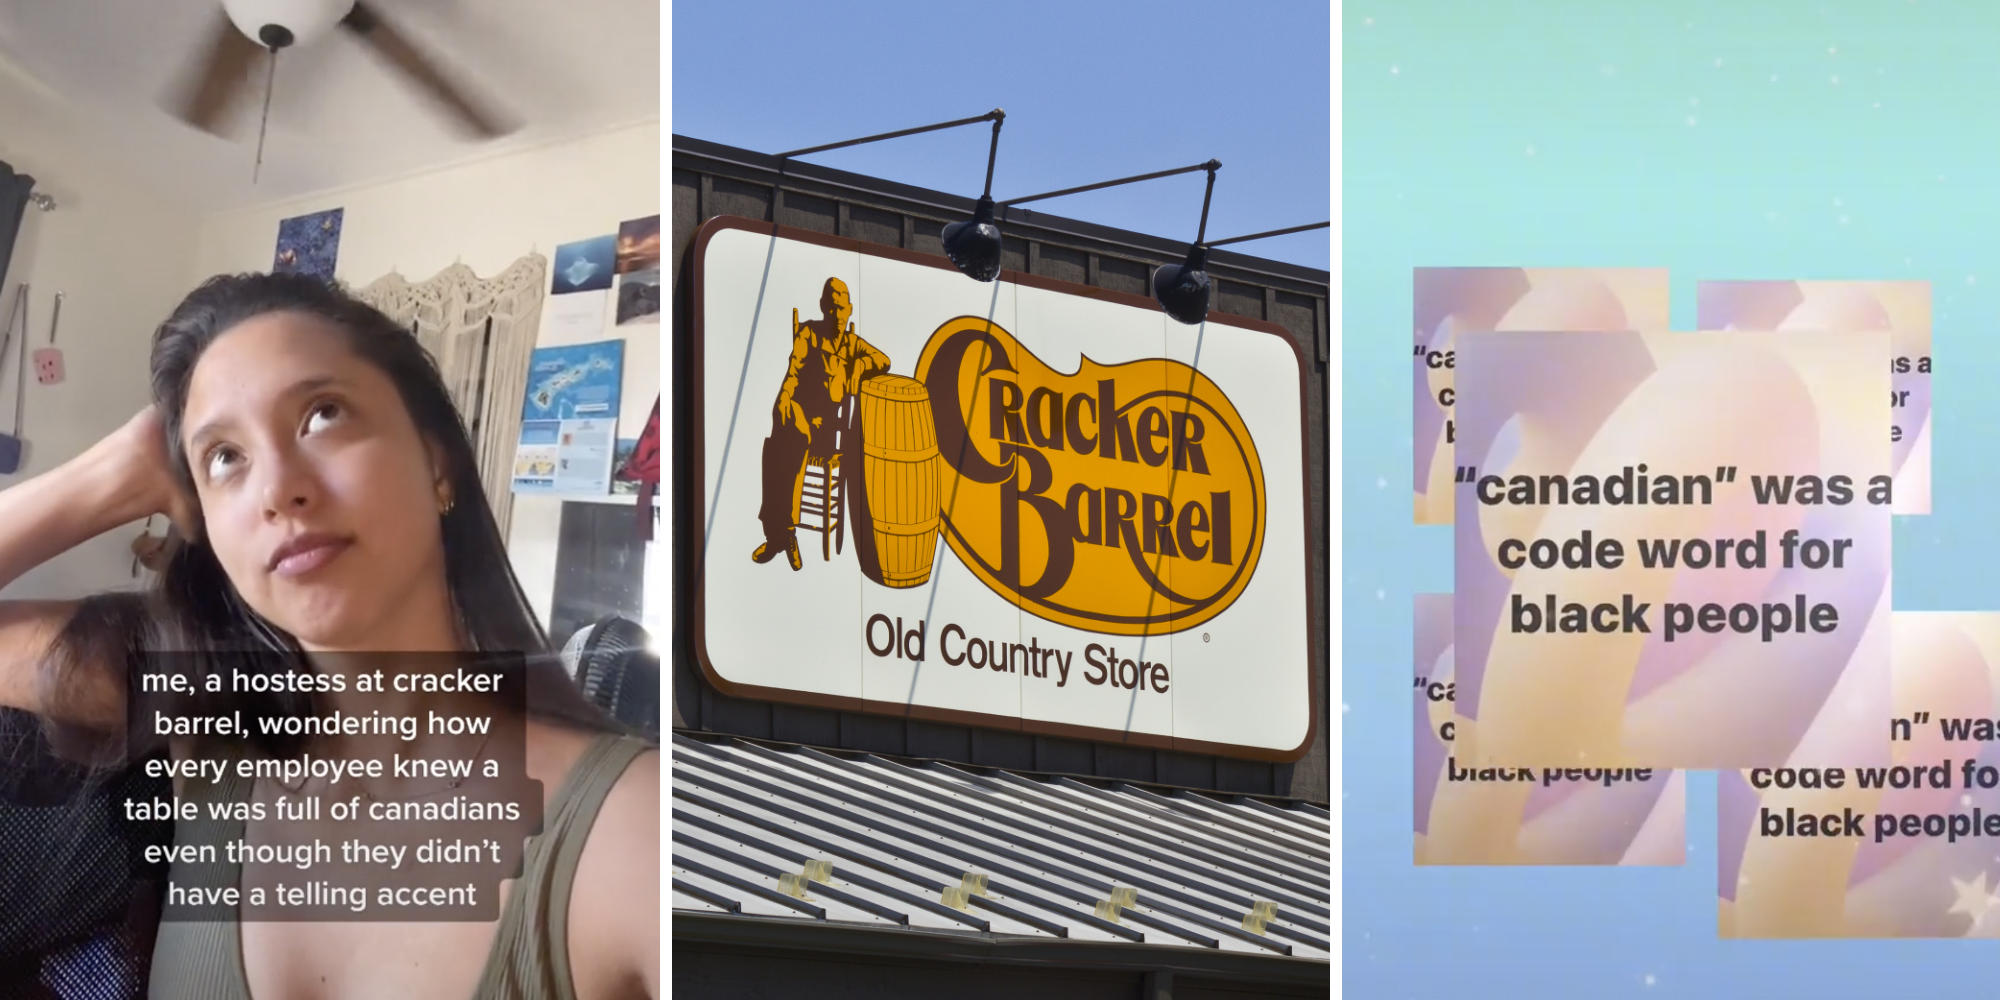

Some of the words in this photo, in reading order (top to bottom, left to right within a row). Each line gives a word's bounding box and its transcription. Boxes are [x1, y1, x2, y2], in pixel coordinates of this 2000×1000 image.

[925, 329, 1211, 484] Cracker
[999, 441, 1233, 600] Barrel
[866, 613, 925, 662] Old
[940, 623, 1072, 688] Country
[1084, 643, 1170, 694] Store
